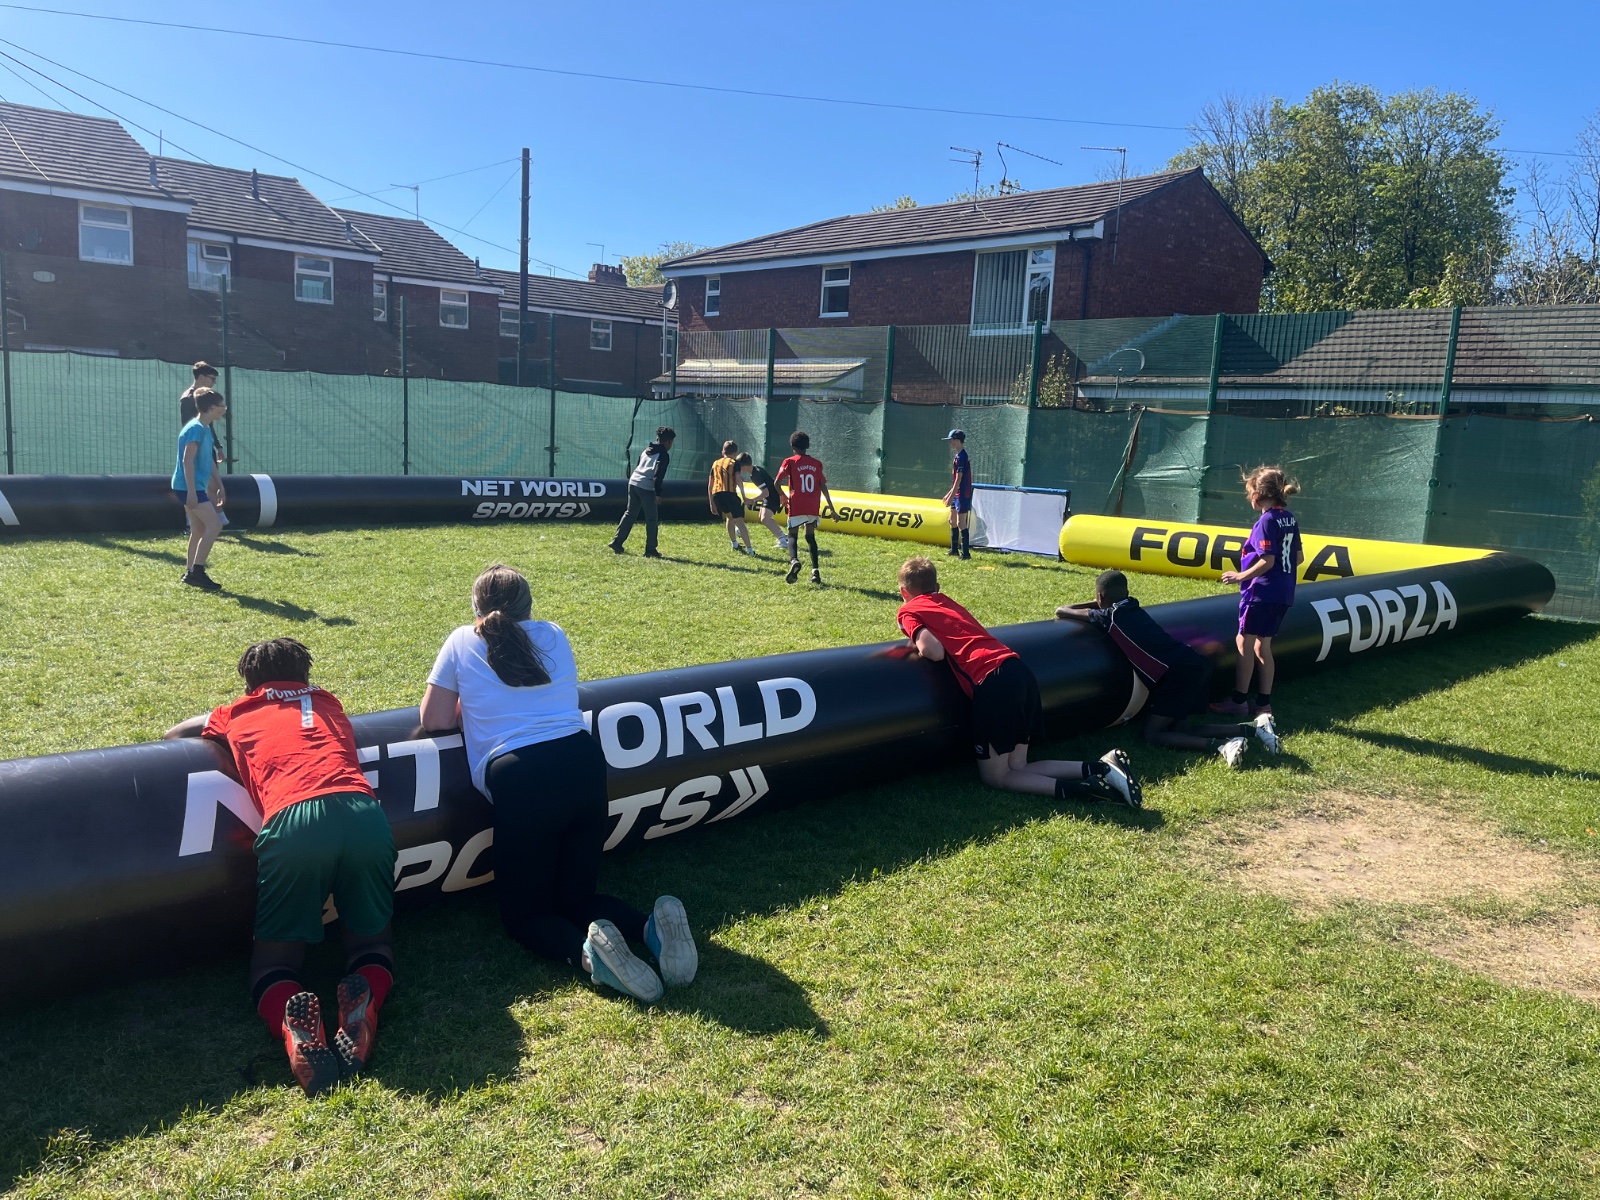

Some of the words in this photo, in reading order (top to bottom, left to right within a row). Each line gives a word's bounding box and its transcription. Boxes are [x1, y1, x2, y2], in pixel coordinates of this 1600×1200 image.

[461, 480, 514, 496] NET
[520, 481, 606, 497] WORLD
[800, 473, 815, 493] 10
[472, 502, 577, 518] SPORTS
[839, 506, 911, 528] SPORTS
[1129, 526, 1355, 581] FORA
[1310, 580, 1458, 662] FORZA
[583, 677, 817, 769] ORLD
